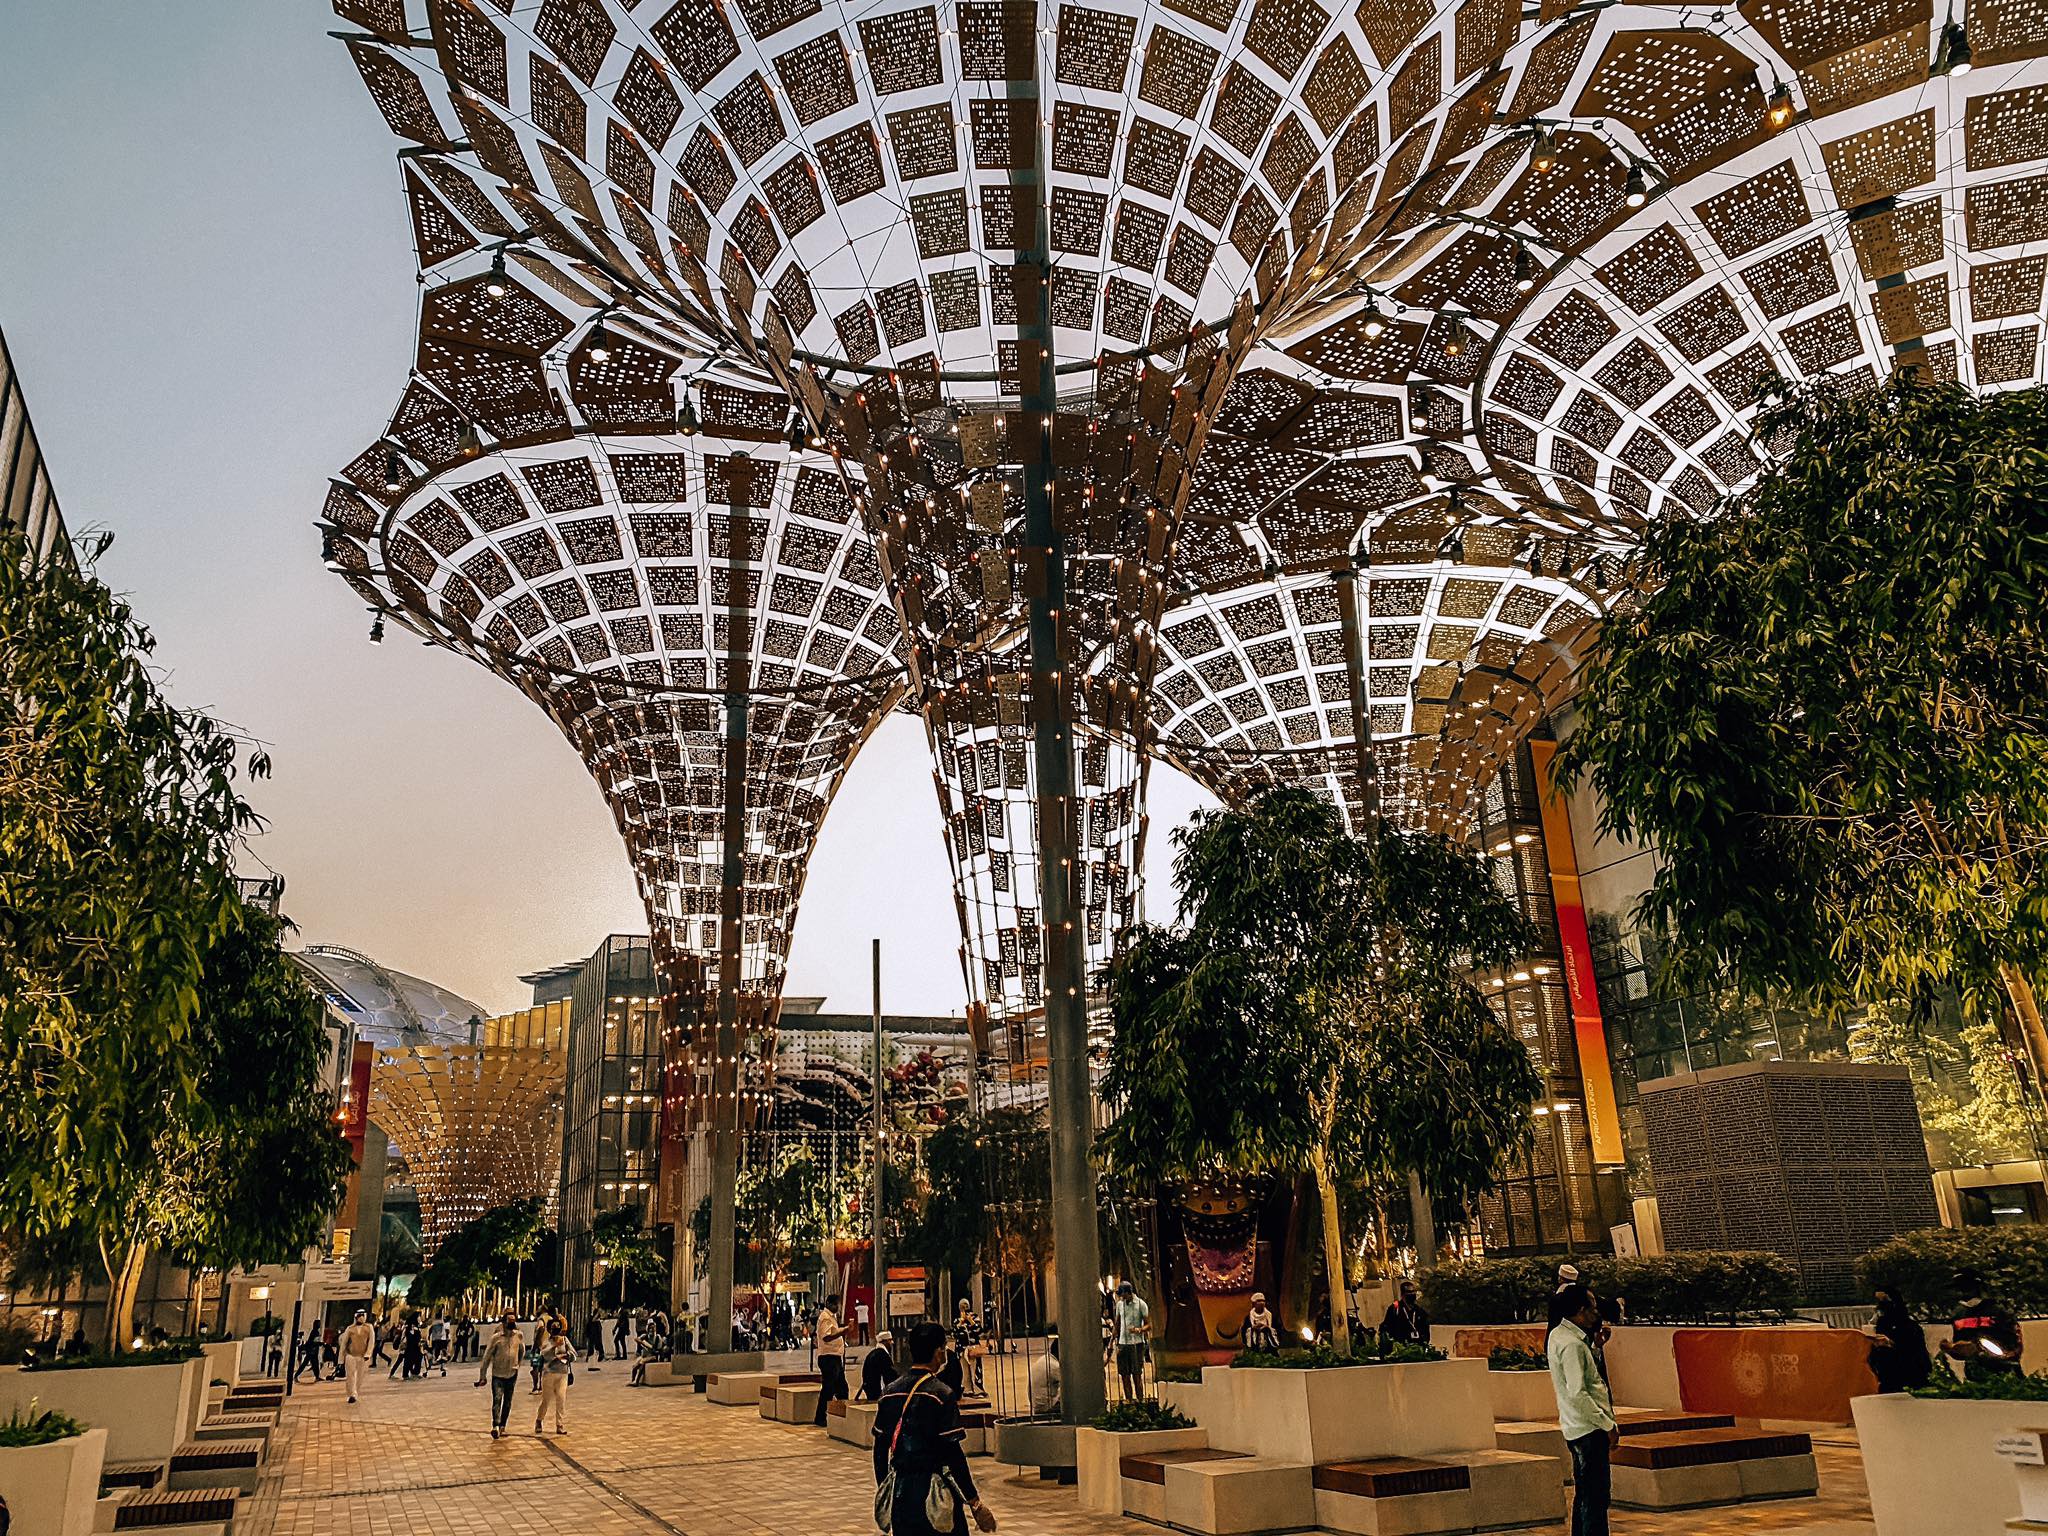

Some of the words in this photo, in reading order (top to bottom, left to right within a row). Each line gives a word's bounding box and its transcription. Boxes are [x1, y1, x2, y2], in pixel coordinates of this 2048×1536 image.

[1586, 1078, 1597, 1107] UNION
[1591, 1107, 1602, 1145] AFRICAN
[1771, 1353, 1799, 1365] EXPO
